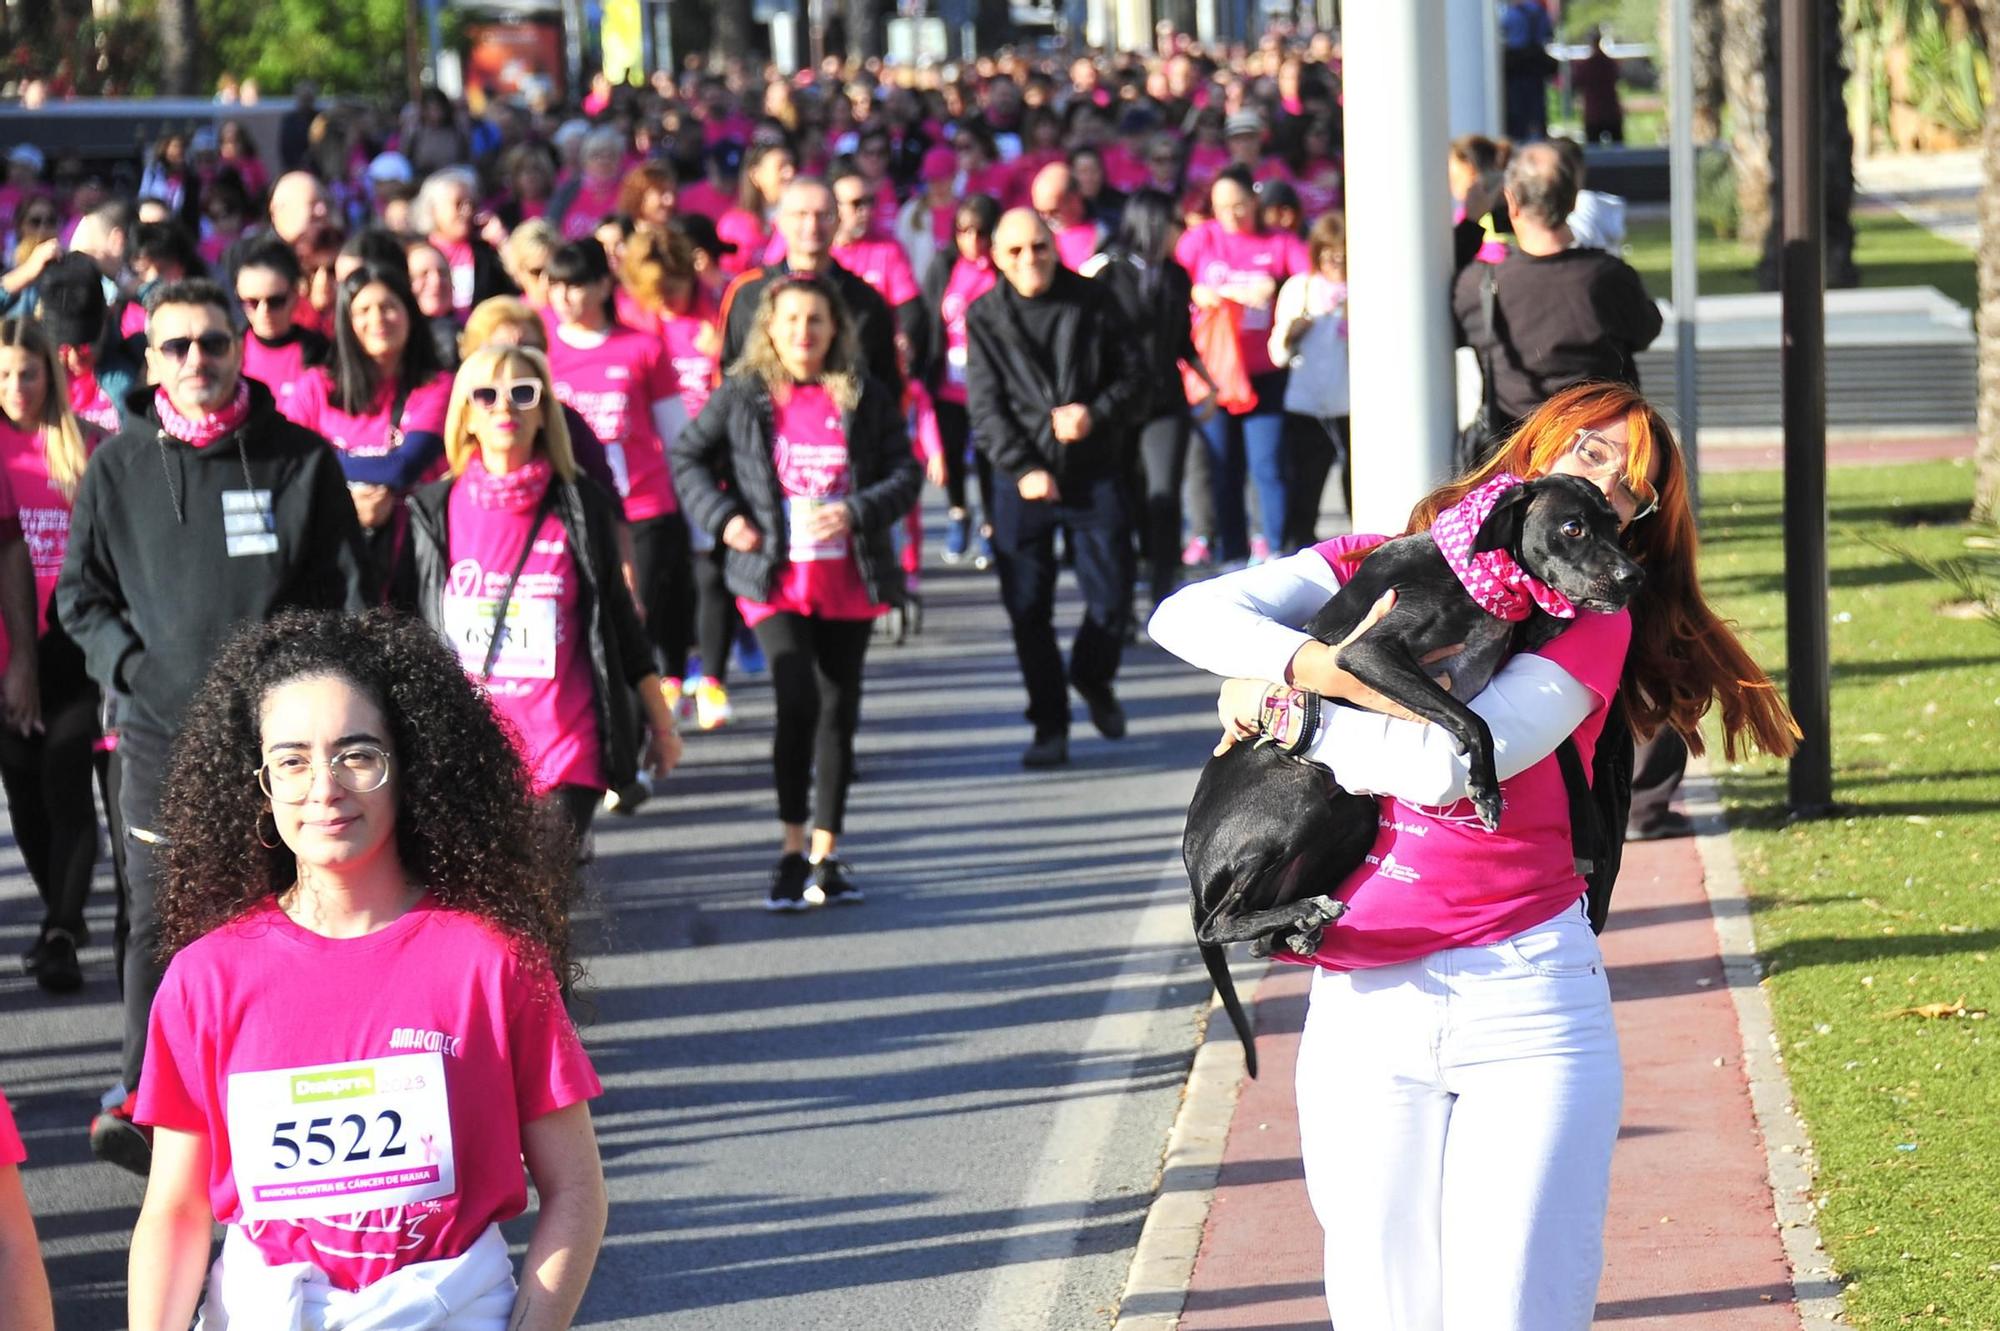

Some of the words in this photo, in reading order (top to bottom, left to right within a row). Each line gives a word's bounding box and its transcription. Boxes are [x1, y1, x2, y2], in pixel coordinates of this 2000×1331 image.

[272, 1110, 407, 1169] 5522
[297, 1184, 334, 1196] CONTRA
[335, 1182, 346, 1192] EL
[349, 1177, 385, 1190] CÁNCER
[386, 1174, 399, 1185] DE
[400, 1171, 431, 1183] MAMA
